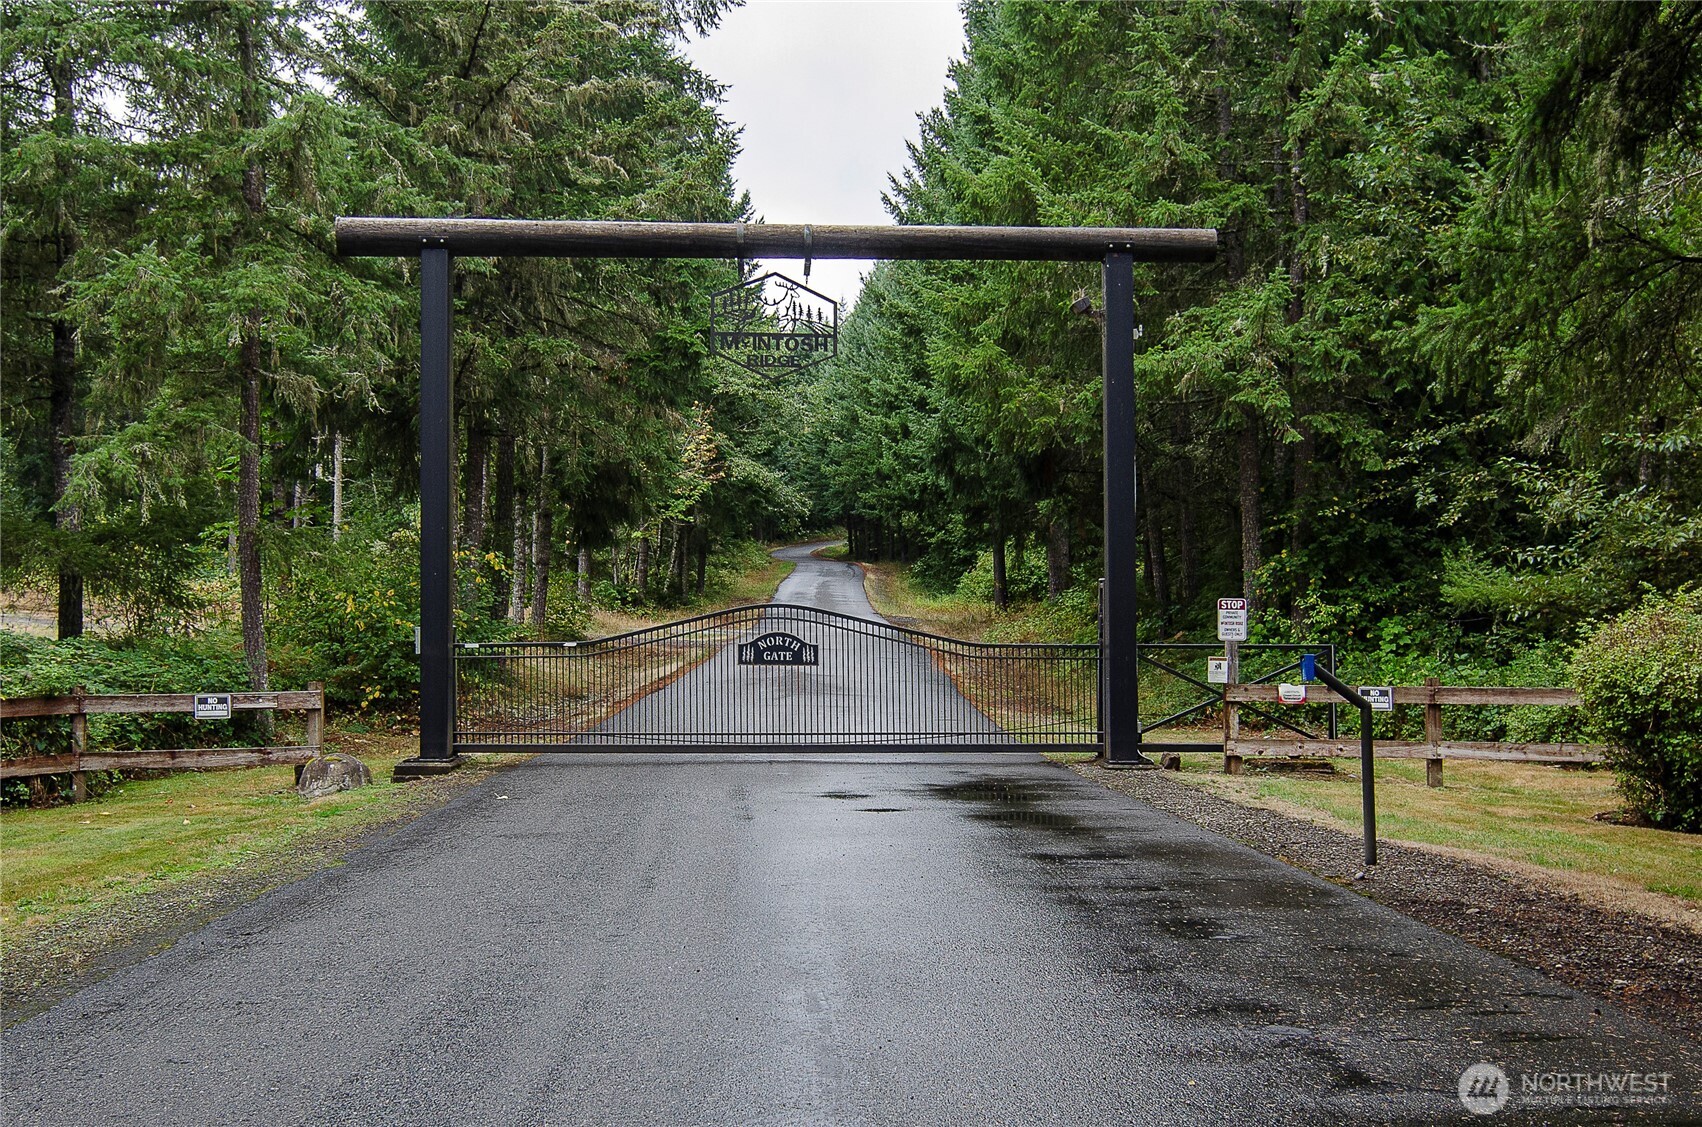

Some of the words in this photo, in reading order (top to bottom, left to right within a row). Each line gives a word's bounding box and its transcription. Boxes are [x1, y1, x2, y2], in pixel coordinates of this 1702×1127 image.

[746, 354, 801, 366] RIDGE
[1220, 600, 1244, 609] STOP
[757, 636, 801, 651] NORTH
[763, 651, 793, 661] GATE
